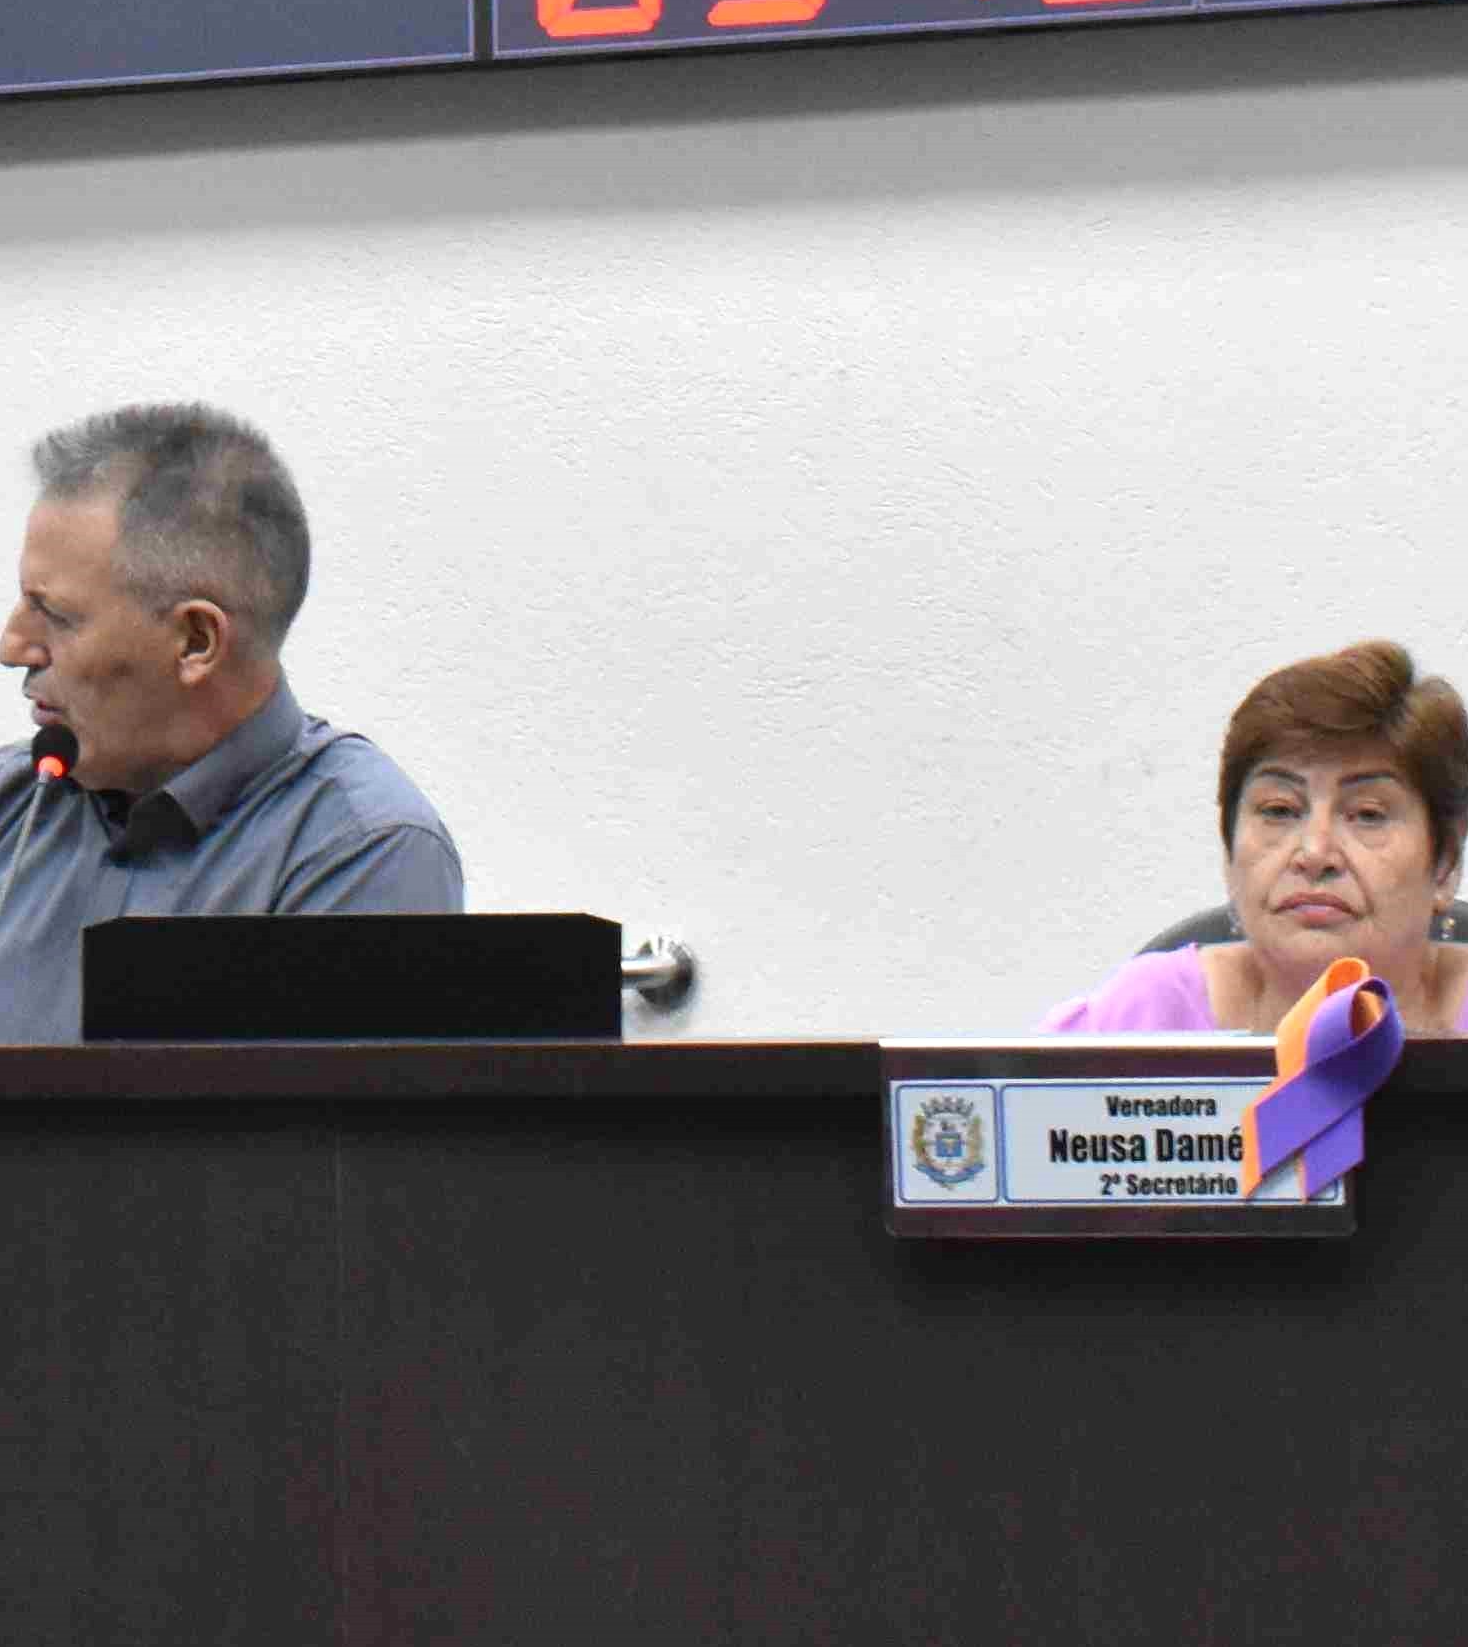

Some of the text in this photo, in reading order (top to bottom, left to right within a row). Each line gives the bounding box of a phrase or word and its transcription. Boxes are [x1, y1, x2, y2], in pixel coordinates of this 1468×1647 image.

[1105, 1094, 1217, 1118] Vereadora
[1049, 1126, 1244, 1164] Neusa Damé
[1126, 1172, 1238, 1196] Secretário
